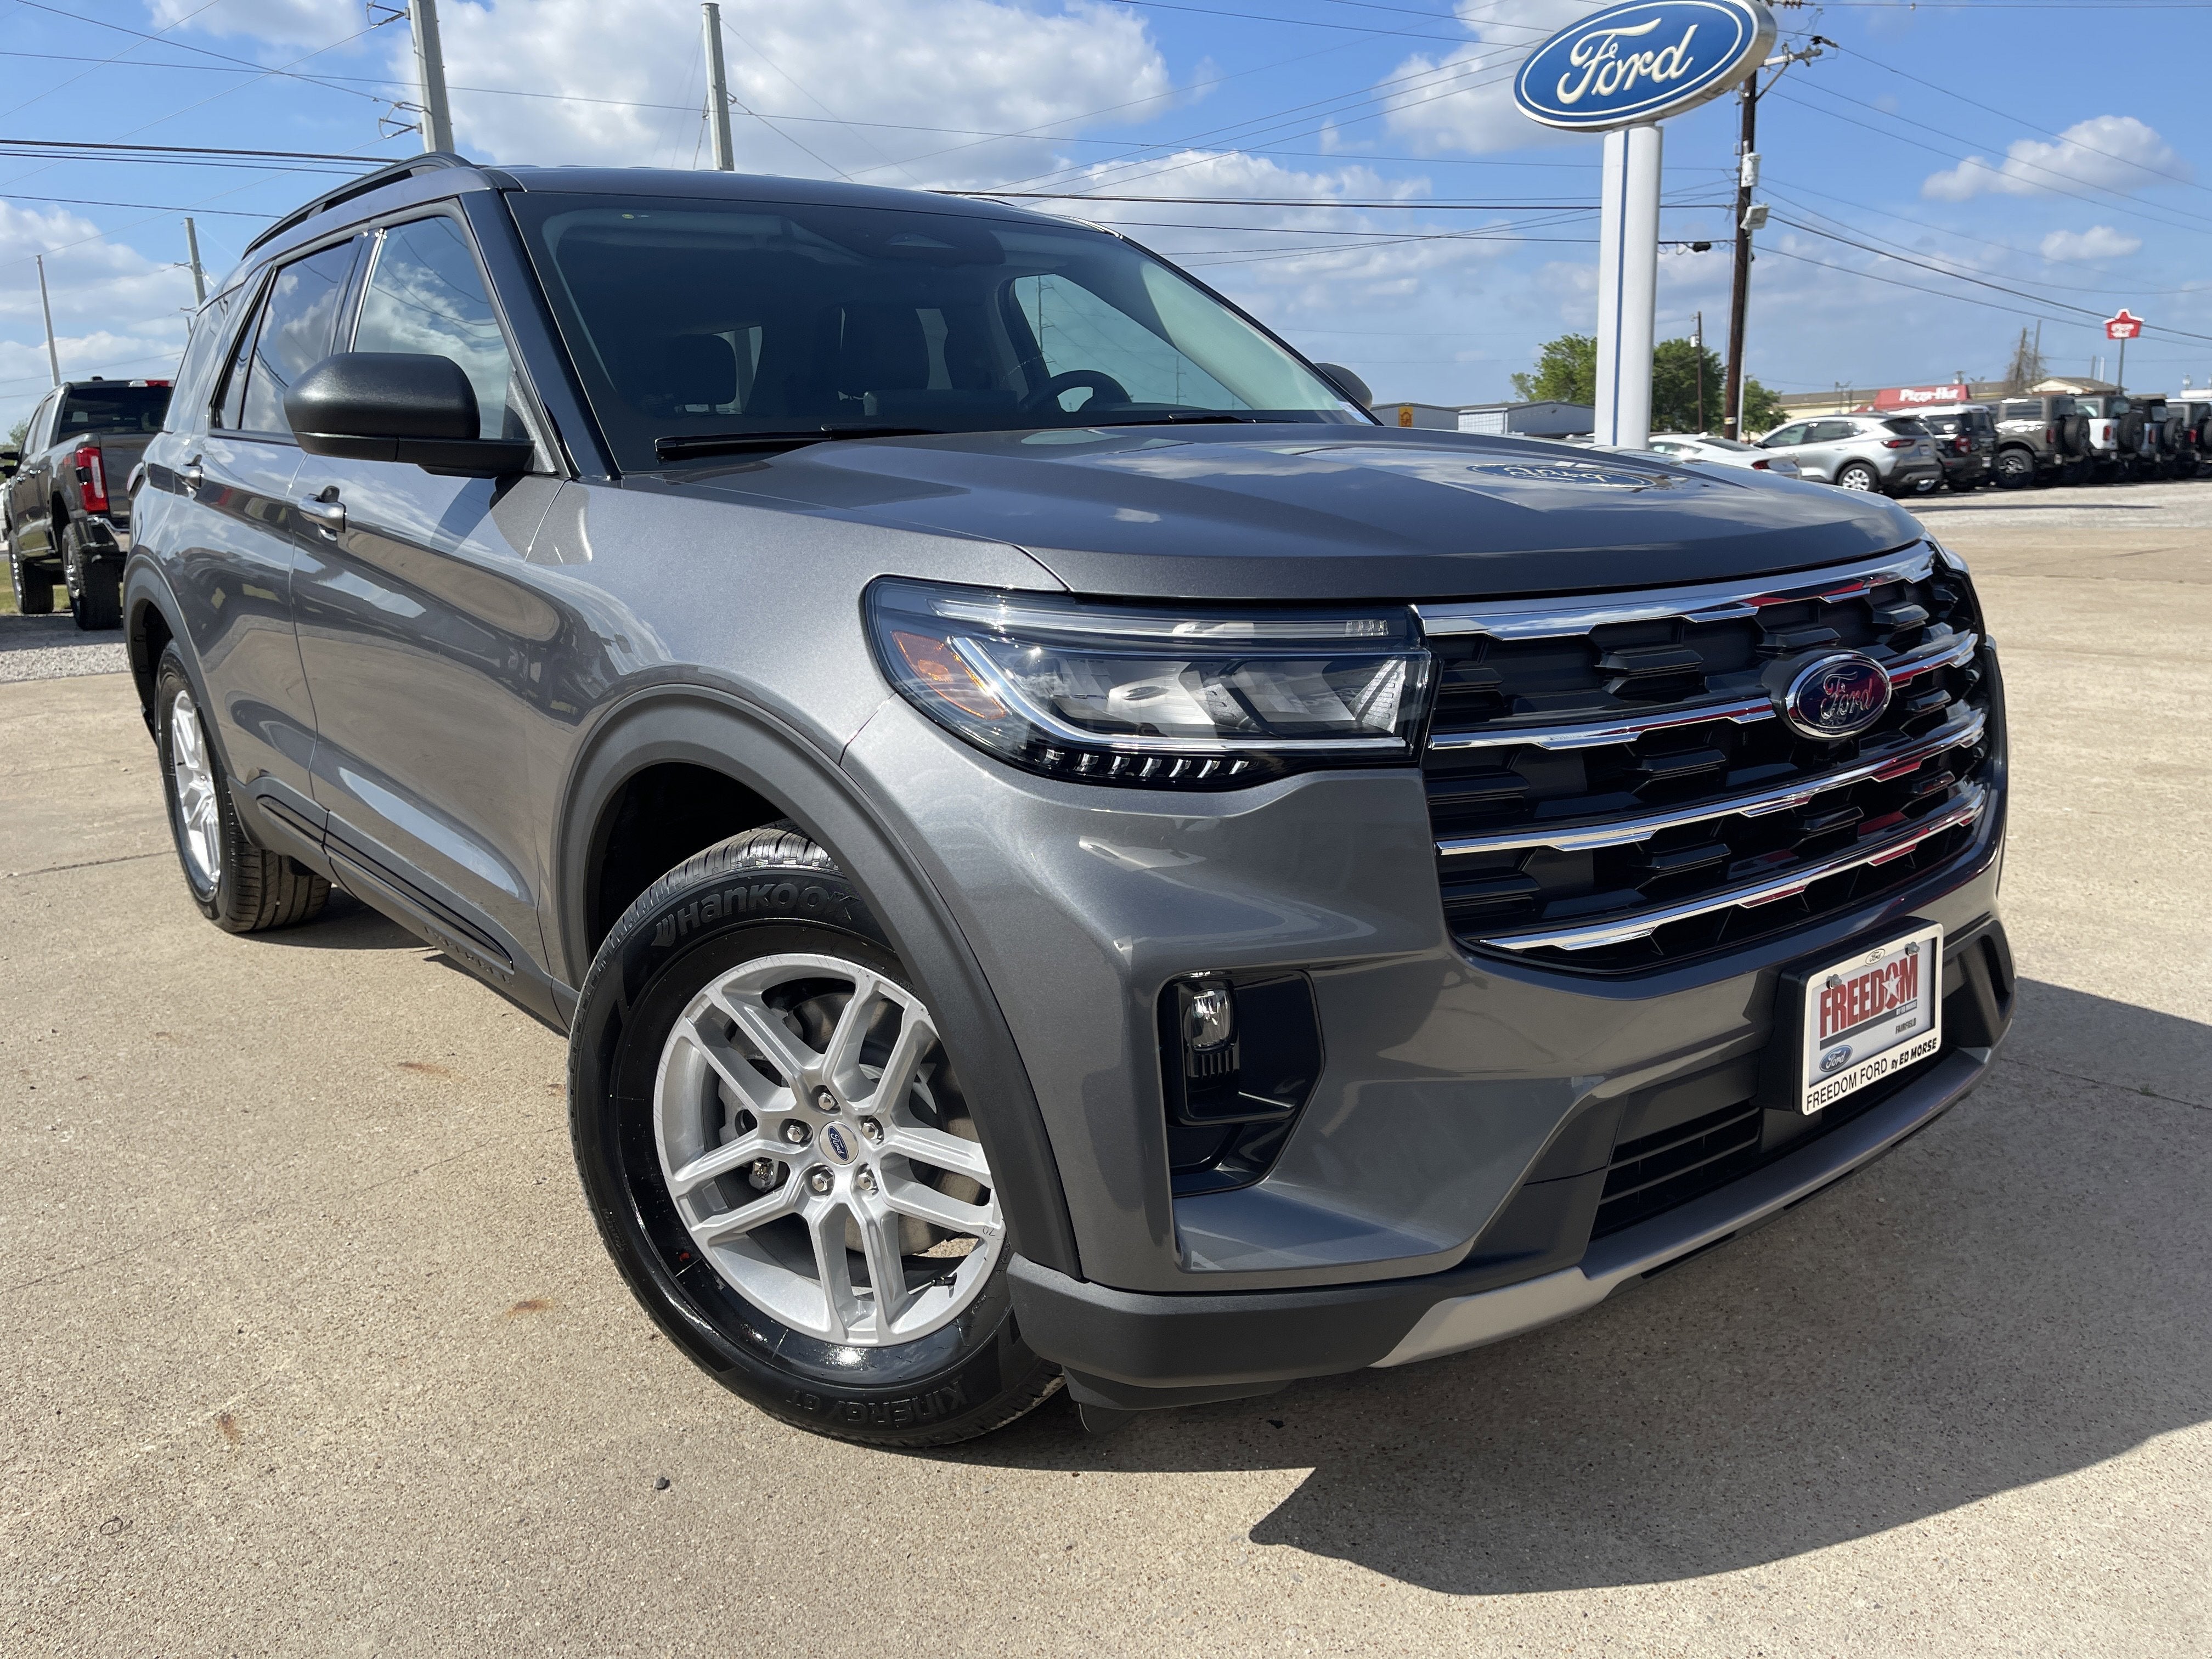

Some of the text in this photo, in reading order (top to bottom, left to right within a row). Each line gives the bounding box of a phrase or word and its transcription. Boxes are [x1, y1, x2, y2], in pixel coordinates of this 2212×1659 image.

[1556, 18, 1699, 104] Ford
[1820, 671, 1874, 720] Ford
[1820, 953, 1918, 1039] FREEDOM
[1807, 1072, 1857, 1111] FREEDOM
[1860, 1058, 1887, 1085] FORD
[1899, 1050, 1909, 1065] ED
[1910, 1037, 1937, 1060] MORSE
[1826, 1049, 1847, 1069] Ford
[830, 1133, 845, 1154] Ford
